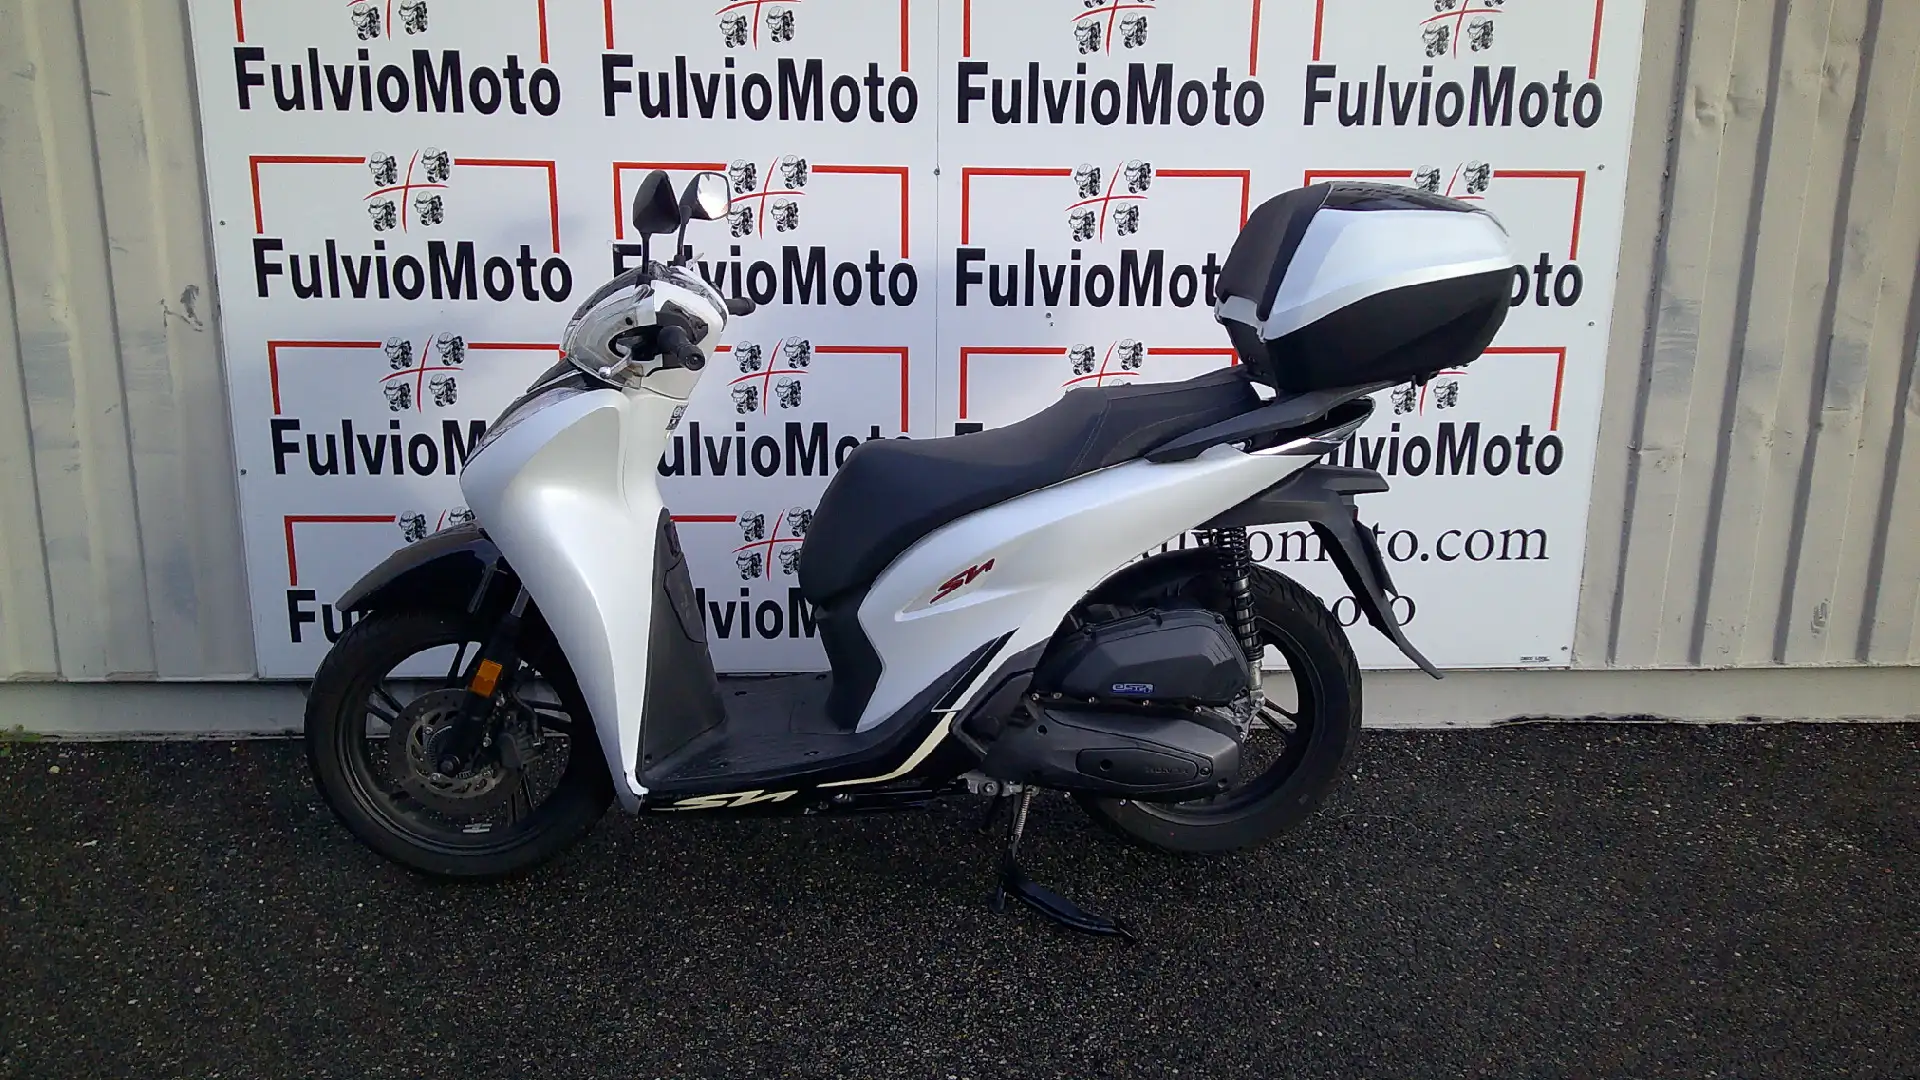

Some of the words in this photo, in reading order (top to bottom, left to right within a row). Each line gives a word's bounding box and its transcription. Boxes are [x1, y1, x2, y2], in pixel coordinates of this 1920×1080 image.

[234, 47, 560, 116] FulvioMoto
[602, 54, 918, 123] FulvioMoto
[957, 62, 1264, 126] FulvioMoto
[1304, 64, 1602, 128] FulvioMoto
[253, 238, 572, 302] FulvioMoto
[613, 244, 918, 307] FvioMoto
[956, 248, 1221, 308] FulvioMot
[270, 418, 486, 477] FulvioM
